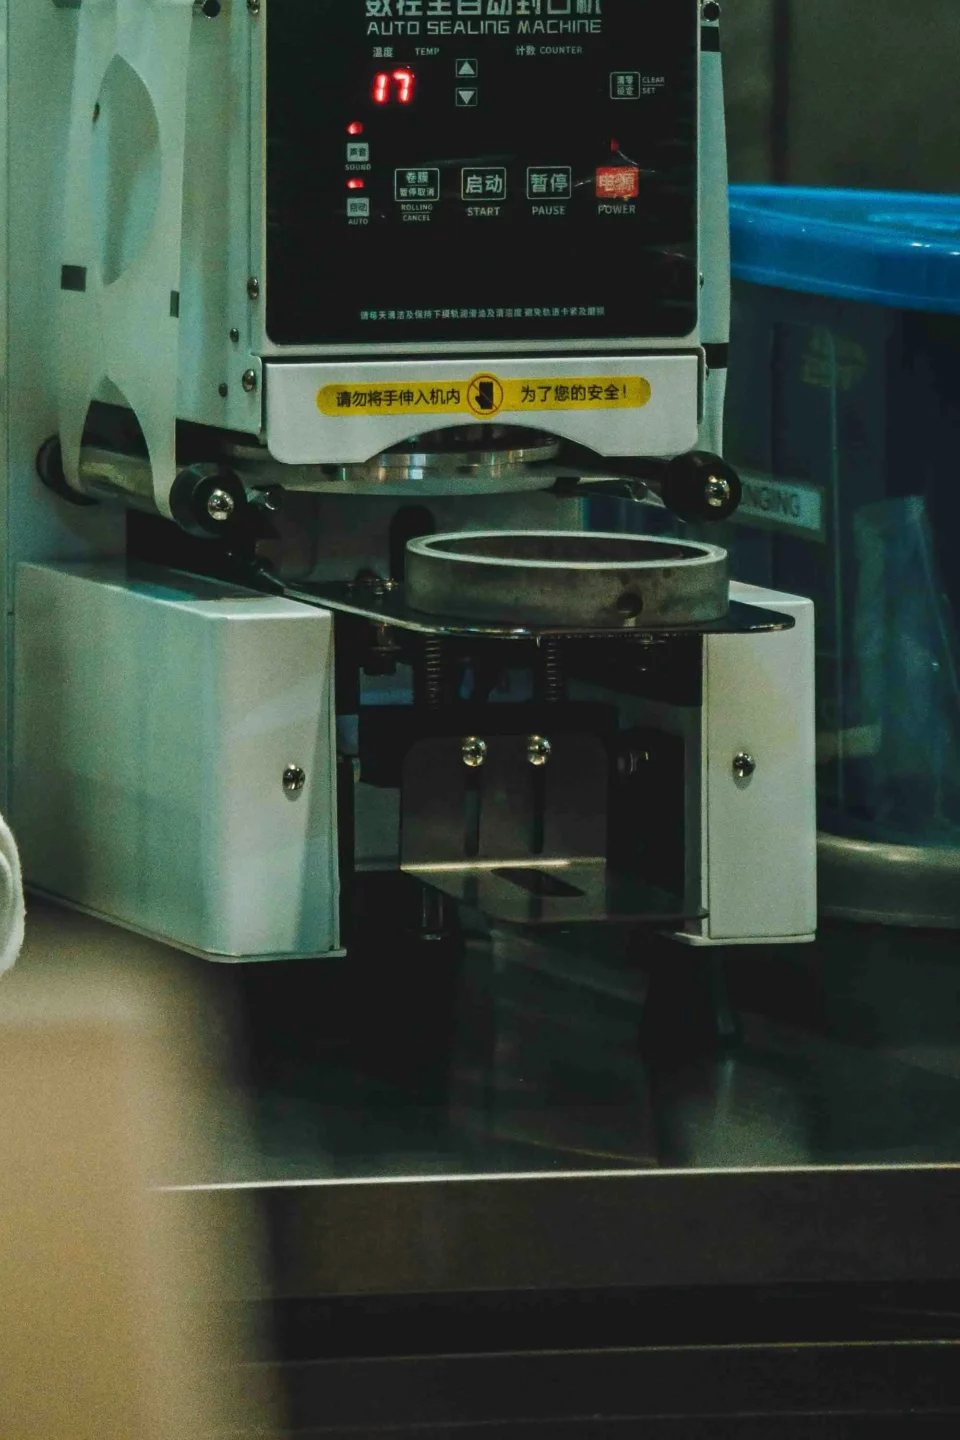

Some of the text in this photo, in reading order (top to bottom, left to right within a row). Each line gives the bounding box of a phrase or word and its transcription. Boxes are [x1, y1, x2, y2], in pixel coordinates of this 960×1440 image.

[366, 19, 603, 35] AUTO SEALING MACHINE
[372, 46, 440, 58] 温度 TEMP
[515, 45, 582, 56] 计数 COUNTER
[642, 76, 665, 84] CLEAR
[374, 70, 413, 103] 17
[345, 163, 372, 171] SOUND
[405, 171, 429, 184] 卷膜
[530, 173, 568, 193] 暂停
[598, 172, 635, 193] 电源
[465, 174, 503, 194] 启动
[401, 203, 433, 211] ROLLING
[466, 207, 501, 216] START
[531, 205, 566, 215] PAUSE
[598, 204, 636, 215] POWER
[402, 214, 431, 222] CANCEL
[336, 387, 461, 409] 请勿将手伸入机内
